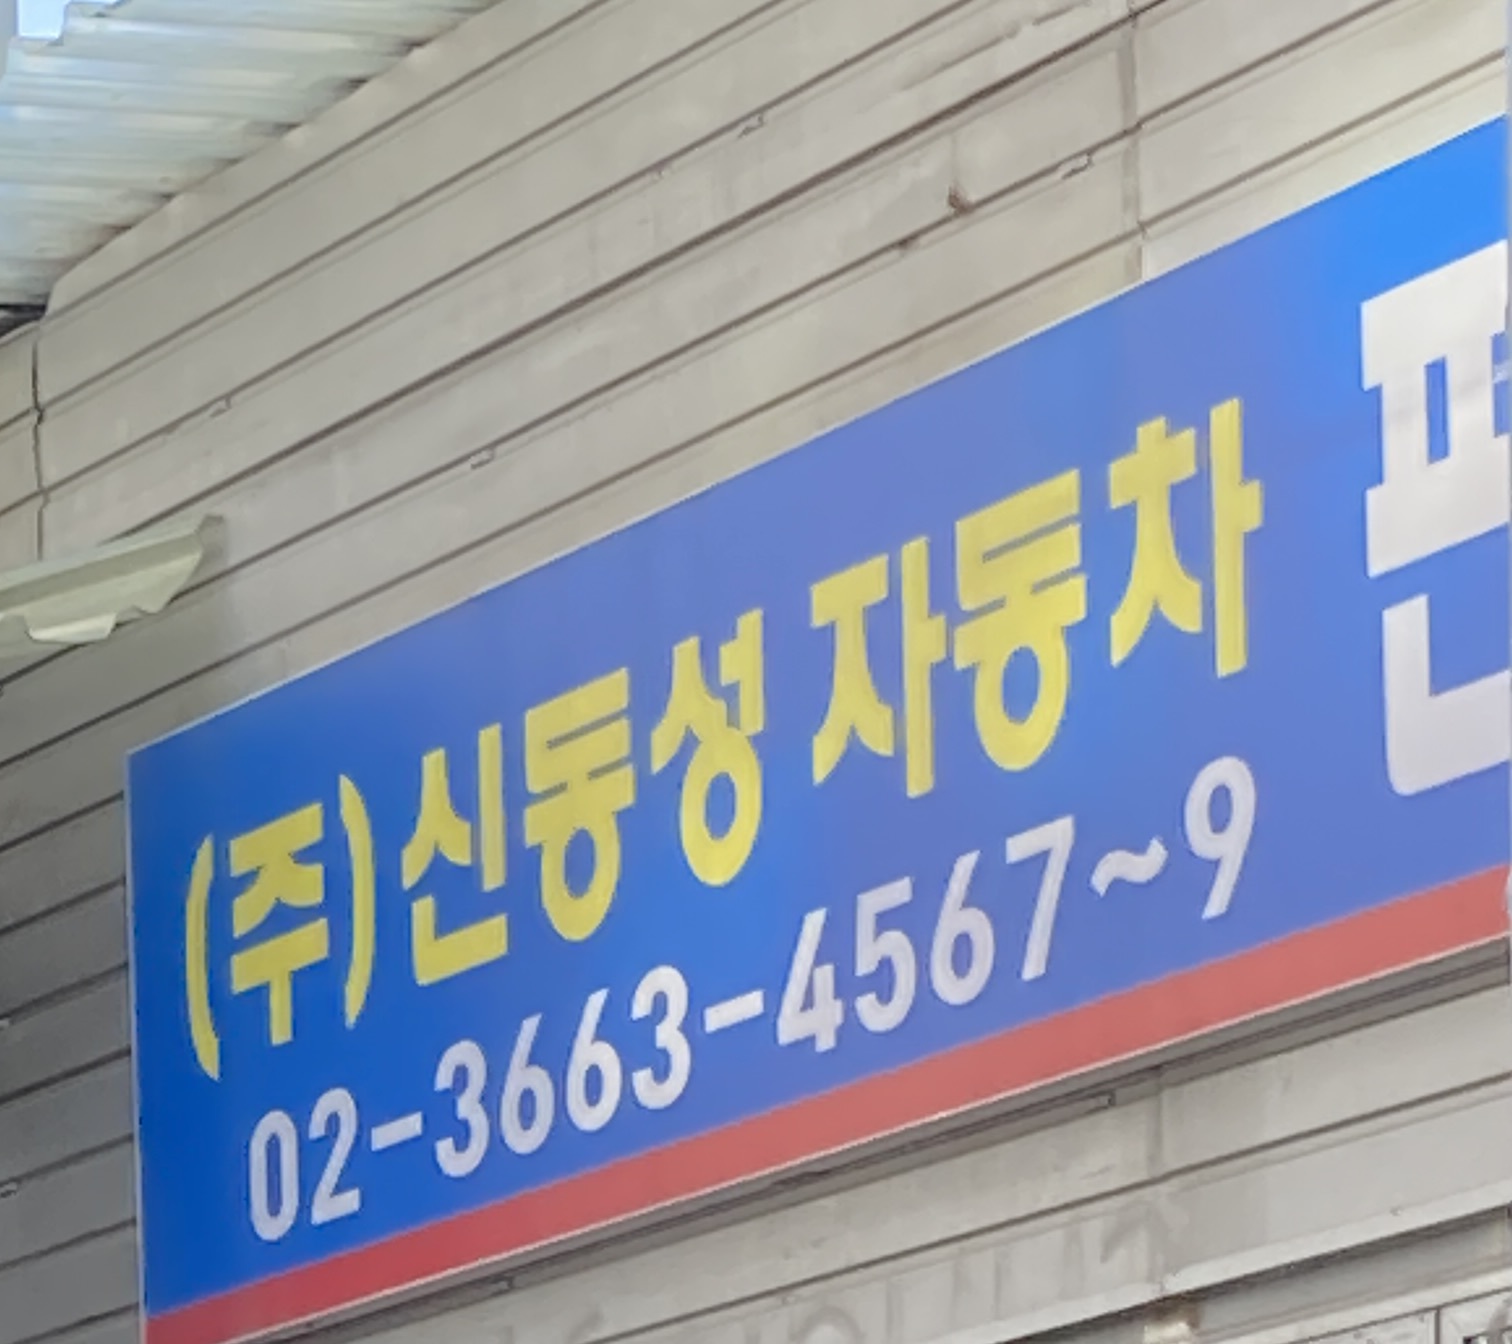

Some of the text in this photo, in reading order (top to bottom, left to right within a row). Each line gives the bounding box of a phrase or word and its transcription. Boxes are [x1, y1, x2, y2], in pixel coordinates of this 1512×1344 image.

[185, 608, 765, 1081] (주)신동성
[809, 397, 1263, 799] 자동차
[246, 756, 1257, 1242] 02-3663-4567~9
